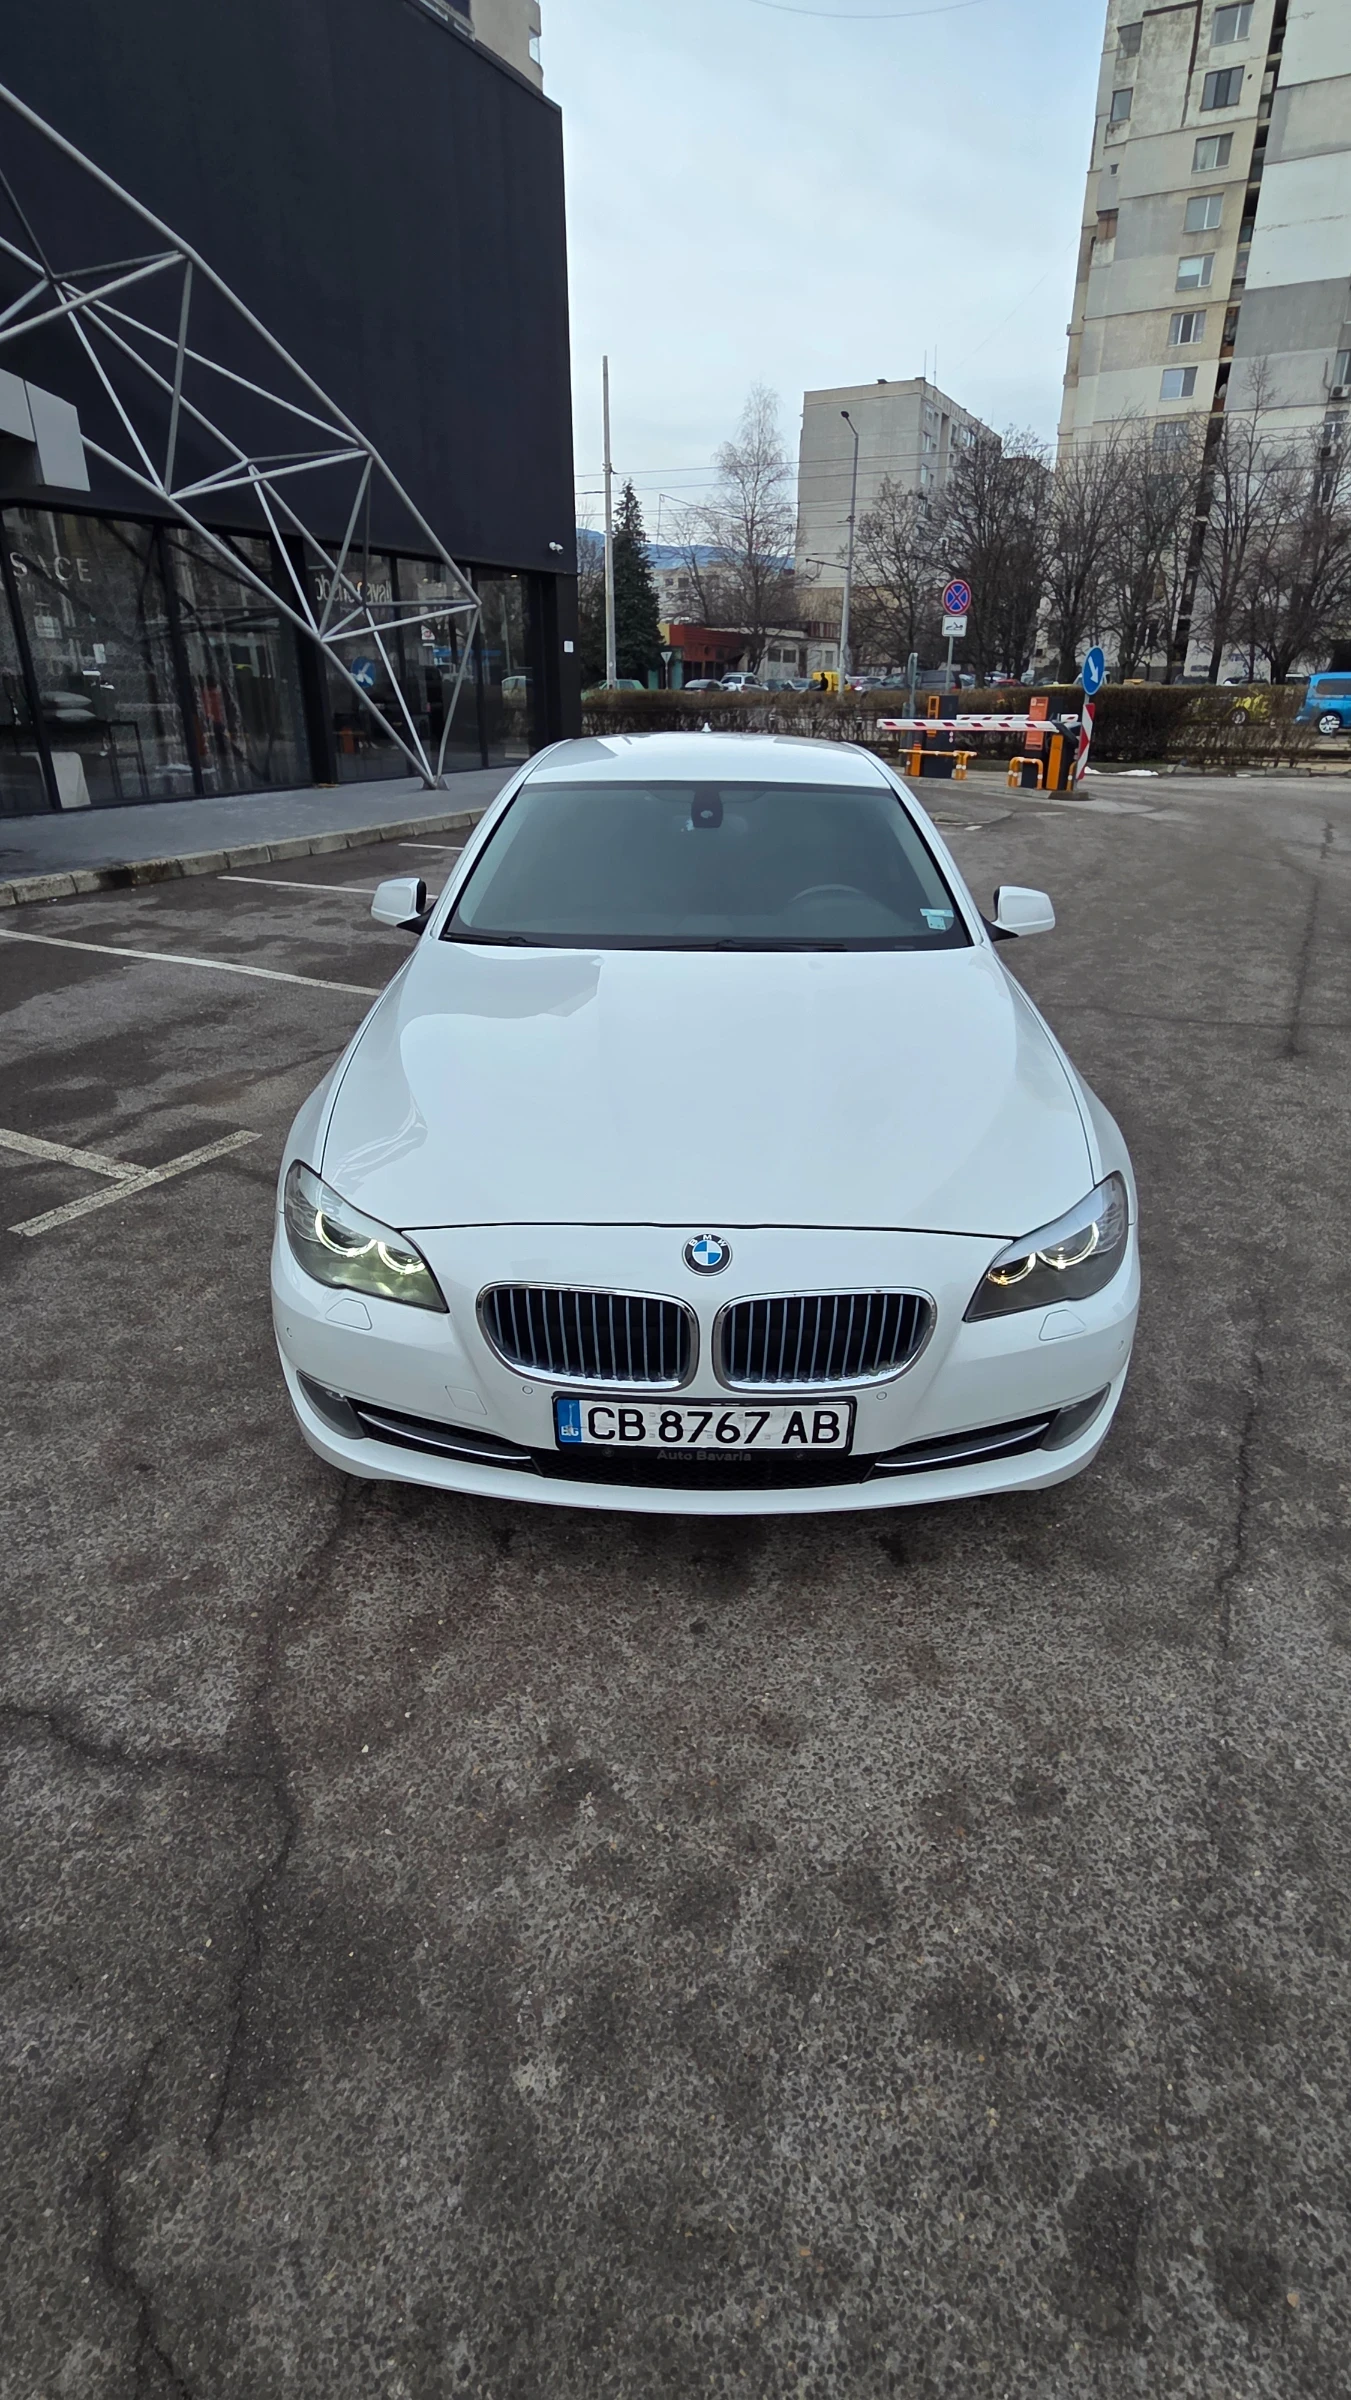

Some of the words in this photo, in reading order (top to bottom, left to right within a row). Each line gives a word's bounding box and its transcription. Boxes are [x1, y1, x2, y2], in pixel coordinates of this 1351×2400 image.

[688, 1234, 727, 1247] BMW
[560, 1424, 580, 1437] BG
[587, 1406, 646, 1442] CB
[658, 1410, 771, 1445] 8767
[781, 1410, 841, 1445] AB
[656, 1449, 693, 1461] Auto
[696, 1450, 752, 1462] Bavaria
